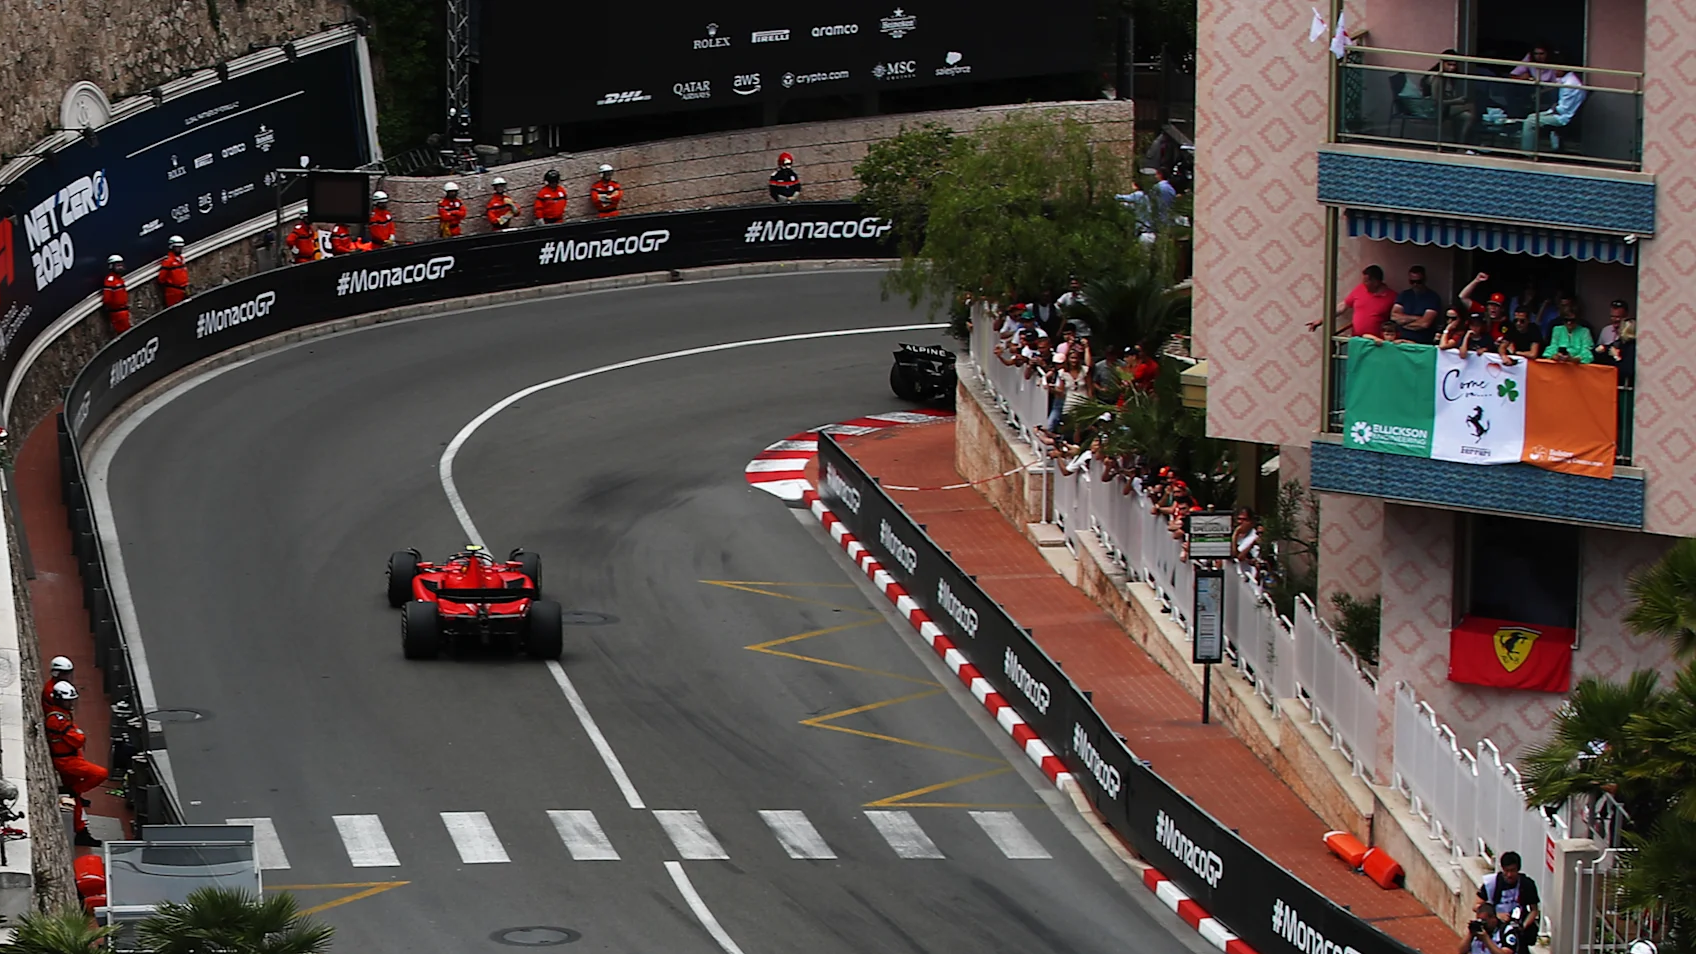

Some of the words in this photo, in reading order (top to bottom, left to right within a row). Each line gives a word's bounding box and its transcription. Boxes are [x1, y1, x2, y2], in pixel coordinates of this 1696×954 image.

[751, 29, 790, 43] PIRELLI
[811, 24, 859, 37] aramco
[693, 37, 731, 49] ROLEX
[887, 60, 916, 75] MSC
[935, 65, 971, 76] salesforce
[734, 73, 760, 87] aws
[796, 70, 849, 84] crypto.com
[673, 81, 710, 95] QATAR
[603, 90, 644, 104] DHL
[24, 195, 59, 252] NET
[58, 169, 109, 227] ZERO
[539, 230, 670, 265] #MonacoGP
[31, 232, 75, 292] 2030
[337, 256, 455, 296] #MonacoGP
[196, 291, 276, 339] #MonacoGP
[905, 344, 946, 357] ALPINE
[110, 337, 159, 389] #MonacoGP
[1372, 424, 1428, 439] ELLICKSON
[1460, 445, 1491, 457] Ferrari
[880, 518, 917, 575] #MonacoGP
[937, 578, 979, 638] #MonacoGP
[1004, 646, 1050, 714] #MonacoGP
[1073, 722, 1121, 800] #MonacoGP
[1156, 809, 1224, 889] #MonacoGP
